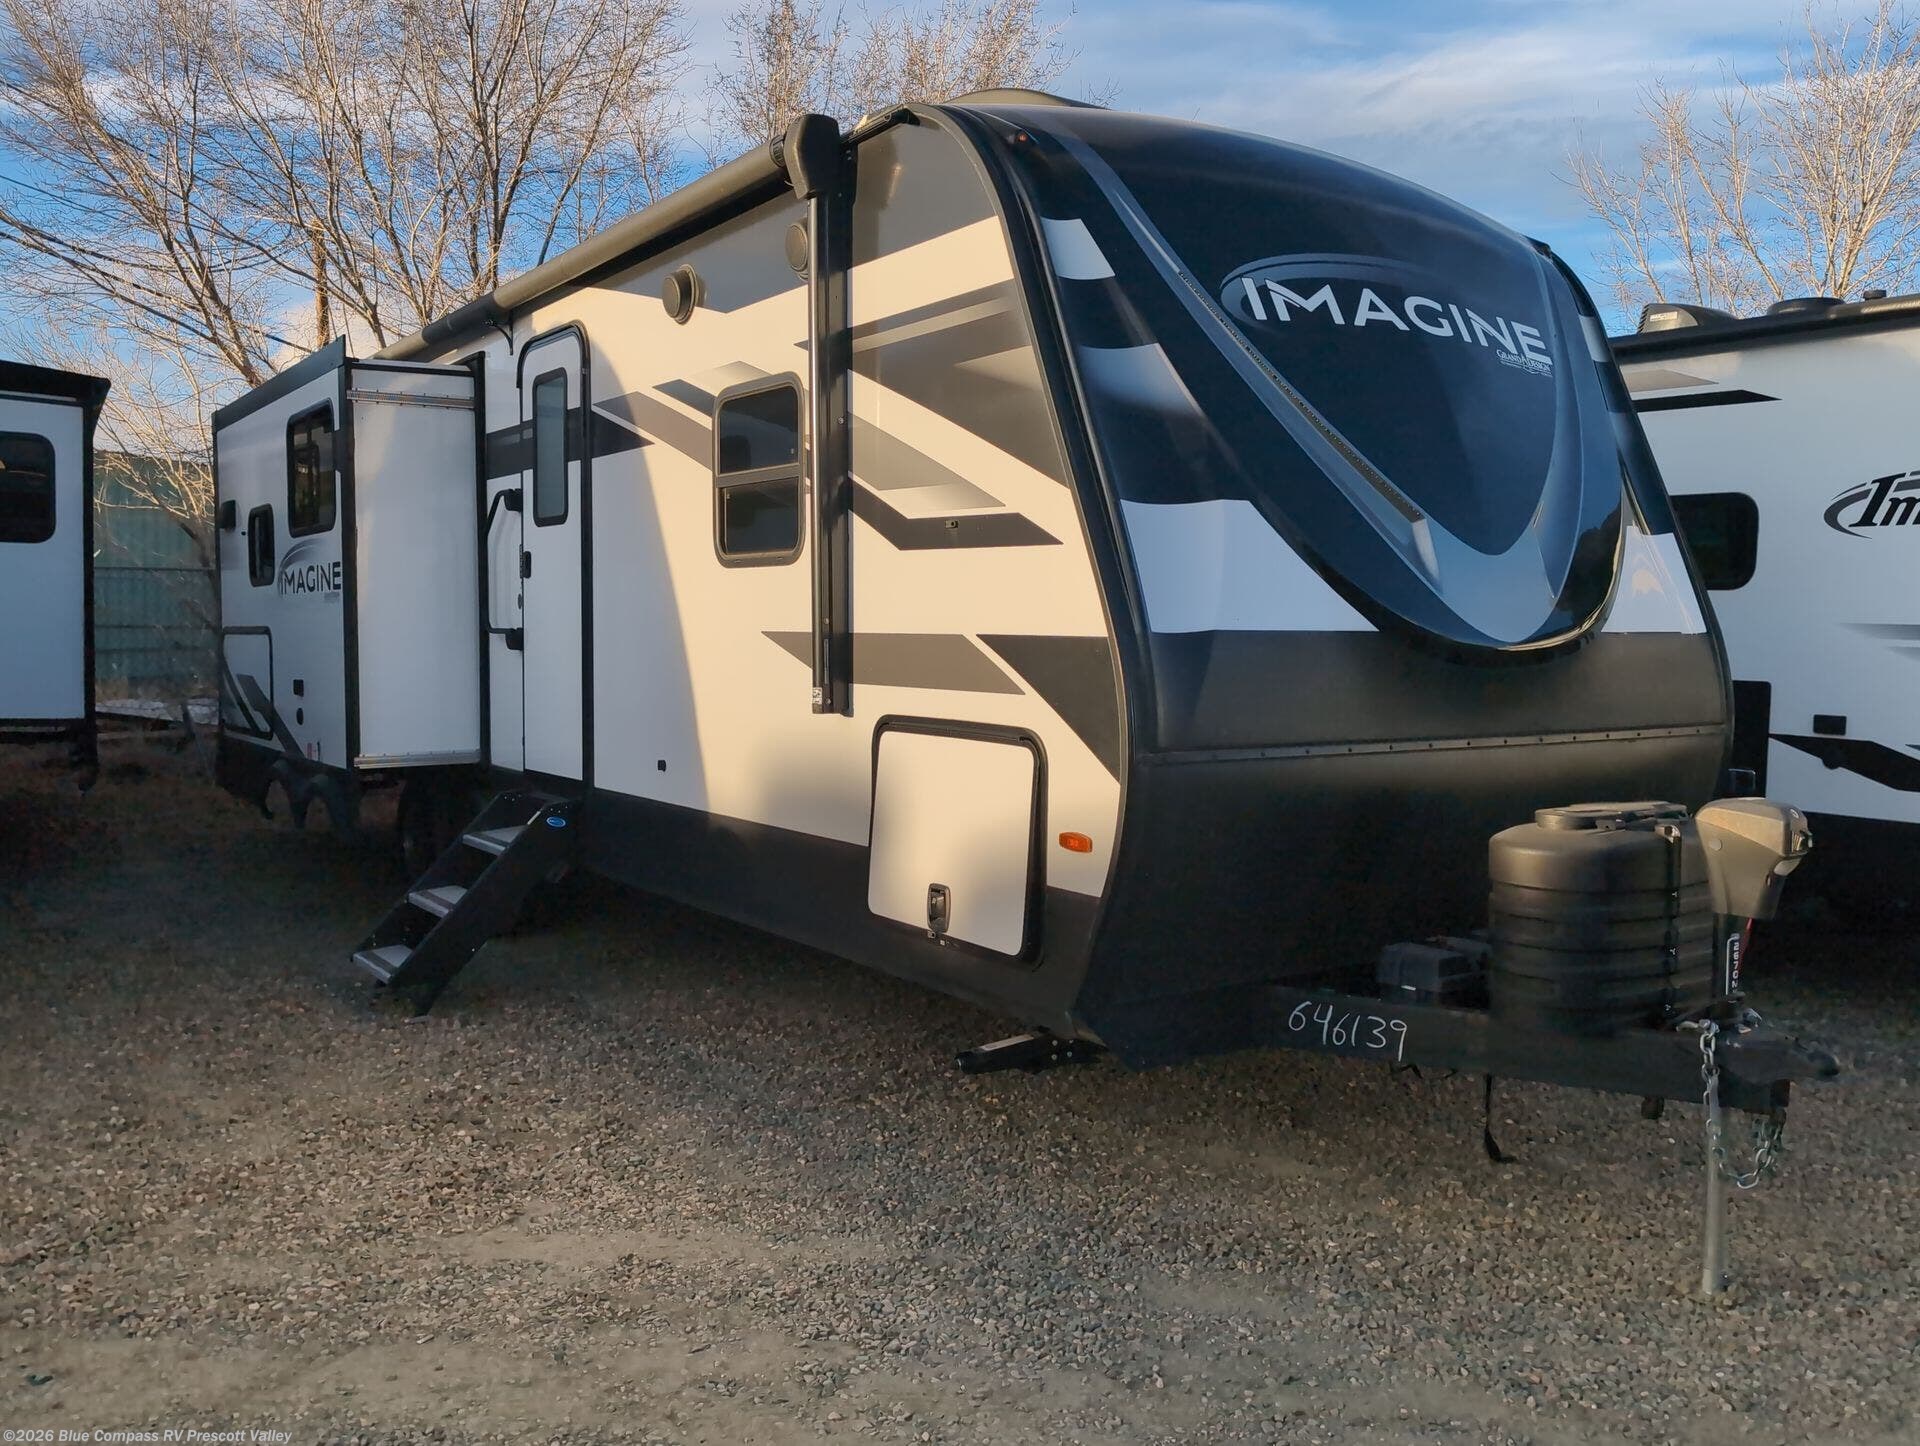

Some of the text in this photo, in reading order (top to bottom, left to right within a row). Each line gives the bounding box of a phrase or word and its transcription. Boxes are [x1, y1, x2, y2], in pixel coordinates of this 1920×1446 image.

[1241, 277, 1553, 365] IMAGINE
[280, 561, 342, 595] IMAGINE
[1288, 1000, 1408, 1062] 646139
